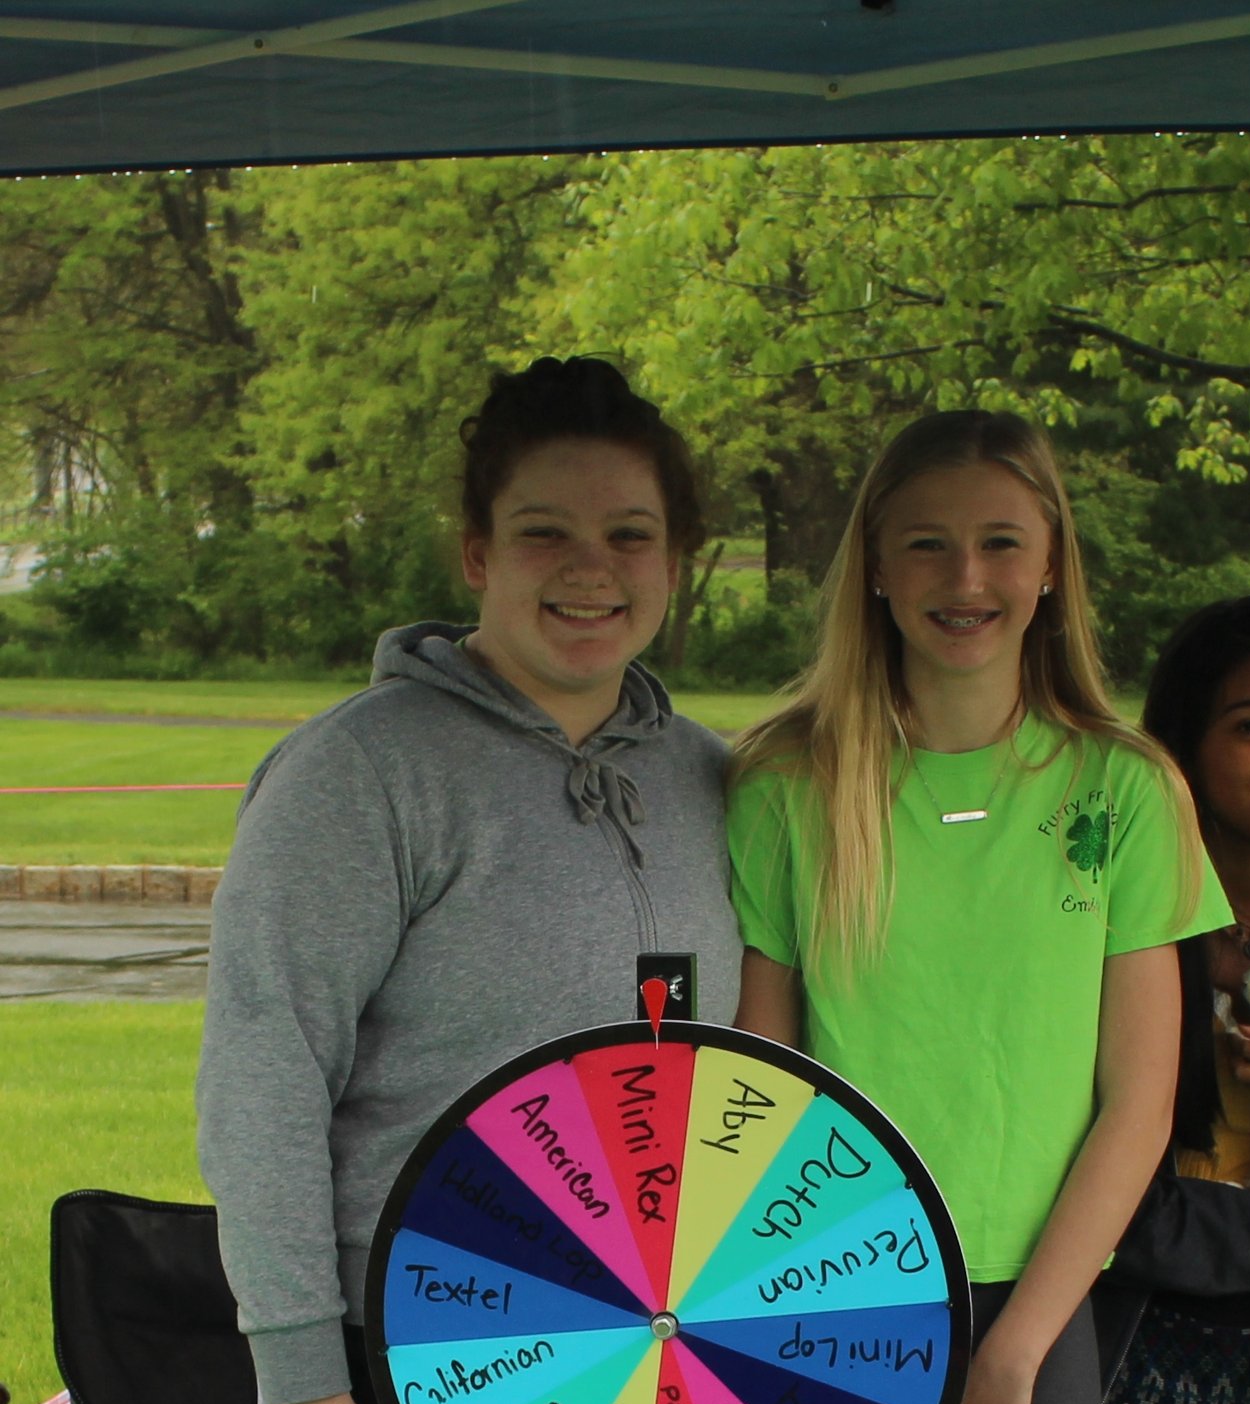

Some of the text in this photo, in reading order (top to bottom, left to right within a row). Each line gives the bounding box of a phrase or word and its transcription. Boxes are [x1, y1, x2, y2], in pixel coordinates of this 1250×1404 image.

[1038, 800, 1080, 836] Fury
[511, 1094, 610, 1219] American
[611, 1064, 677, 1224] Mini Rex
[700, 1078, 776, 1154] Aby
[440, 1158, 544, 1241] Holland
[752, 1126, 871, 1239] Dutch
[405, 1264, 512, 1314] Textel
[758, 1218, 929, 1303] Peruvian
[778, 1321, 933, 1372] Mini Lop
